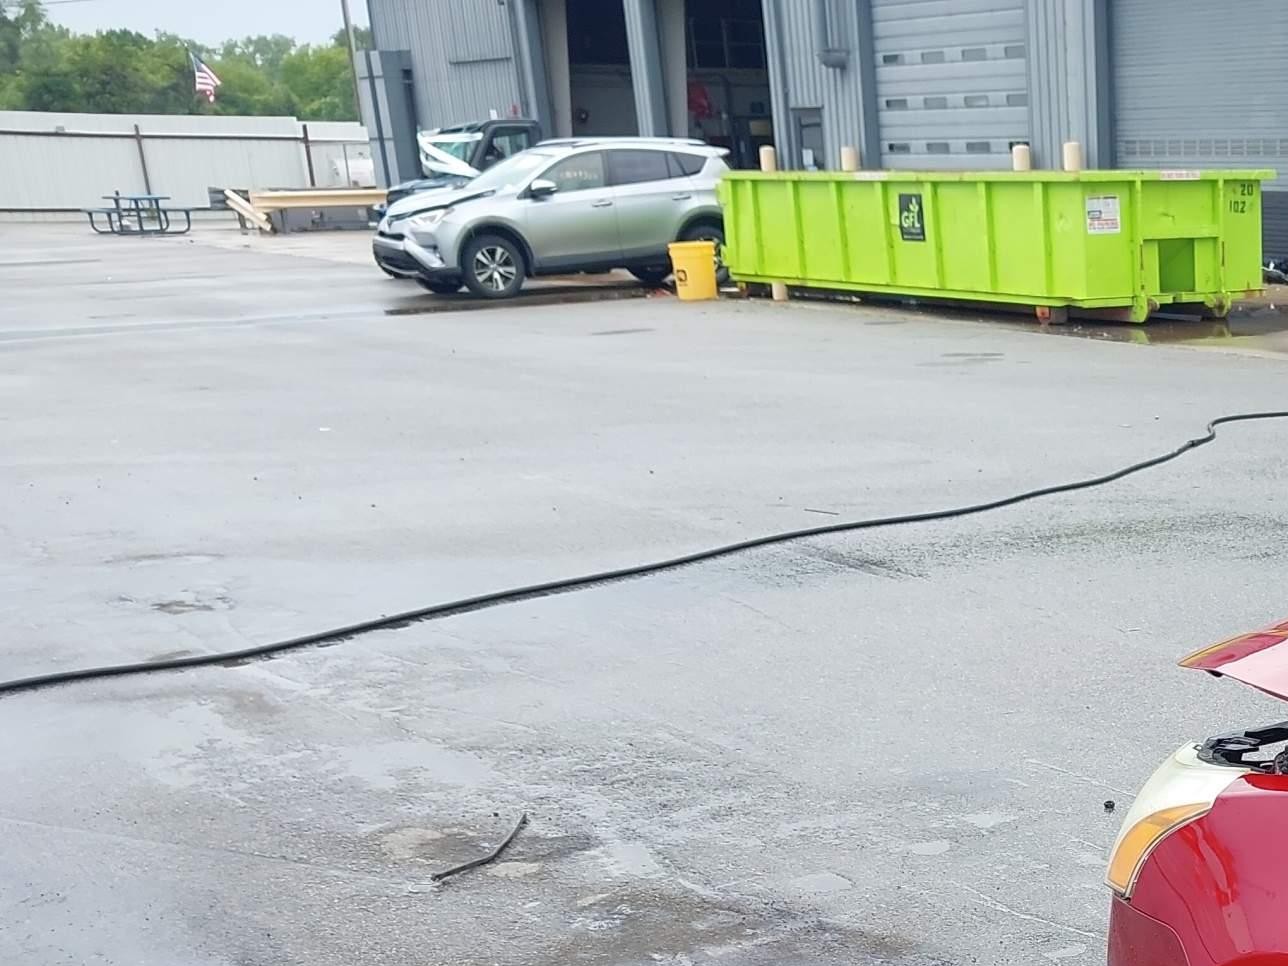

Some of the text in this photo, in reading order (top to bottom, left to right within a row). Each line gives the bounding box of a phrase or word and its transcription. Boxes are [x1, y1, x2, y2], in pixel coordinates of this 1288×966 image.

[1240, 183, 1254, 196] 20
[1229, 200, 1247, 214] 102
[901, 211, 921, 228] GFL
